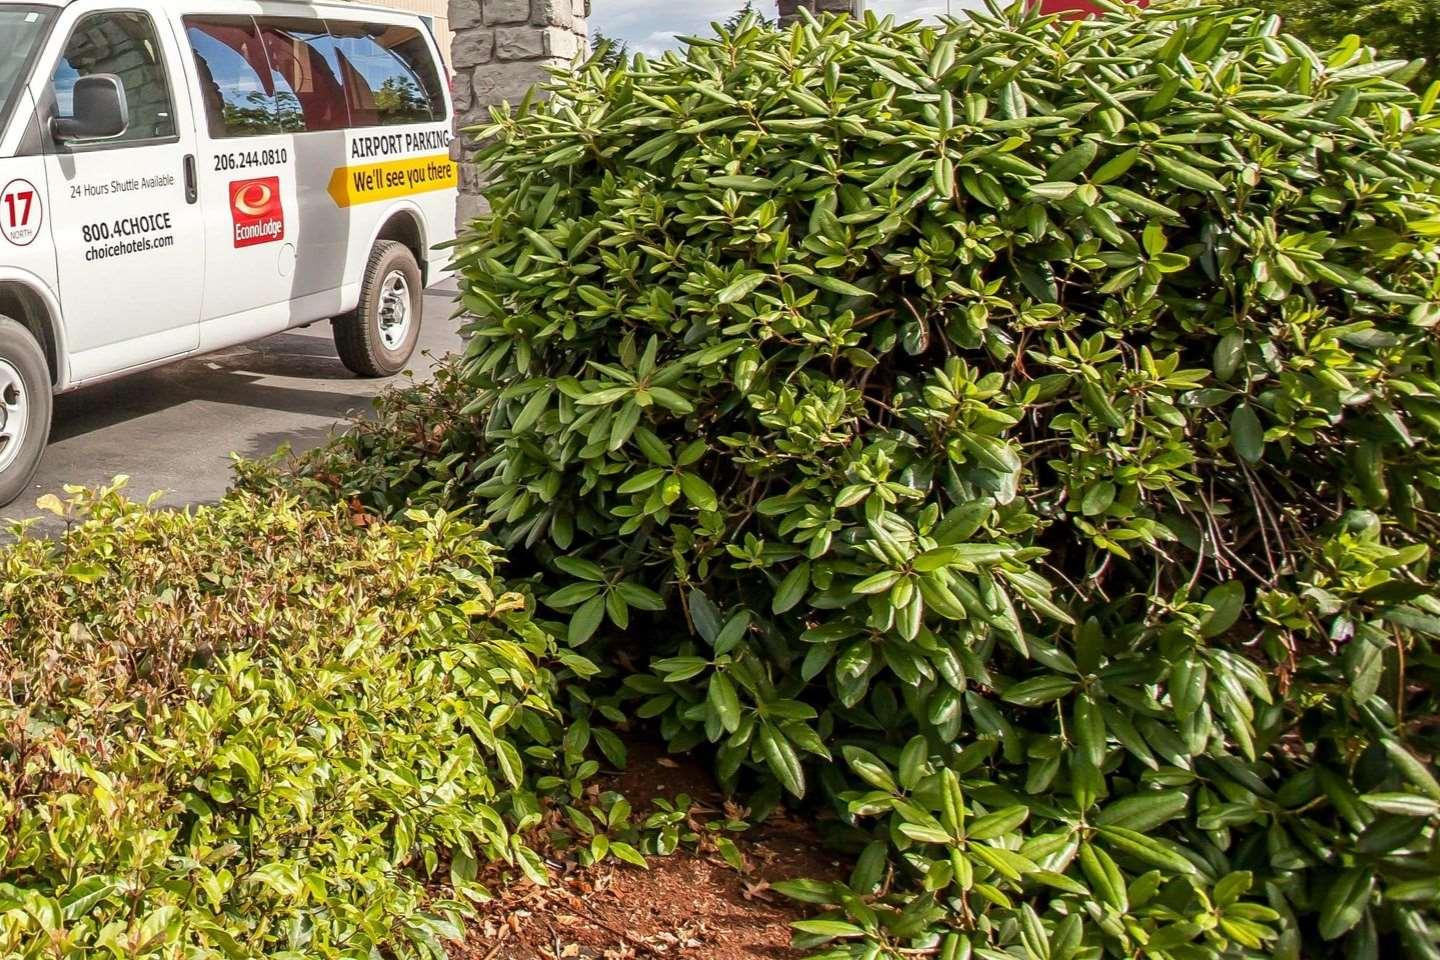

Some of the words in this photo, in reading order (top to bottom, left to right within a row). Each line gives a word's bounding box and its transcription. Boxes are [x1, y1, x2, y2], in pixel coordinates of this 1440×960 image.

[351, 134, 402, 159] AIRPORT
[405, 129, 450, 152] PARKING
[213, 148, 288, 171] 206.244.0810
[70, 185, 81, 199] 24
[84, 182, 109, 197] Hours
[111, 178, 139, 194] Shuttle
[141, 173, 174, 191] Available
[353, 167, 384, 192] We'll
[386, 170, 405, 188] see
[407, 167, 426, 189] you
[427, 161, 452, 181] there
[4, 191, 33, 227] 17
[10, 228, 33, 240] NORTH
[82, 212, 172, 242] 800.4CHOICE
[85, 234, 174, 261] choicehotels.com
